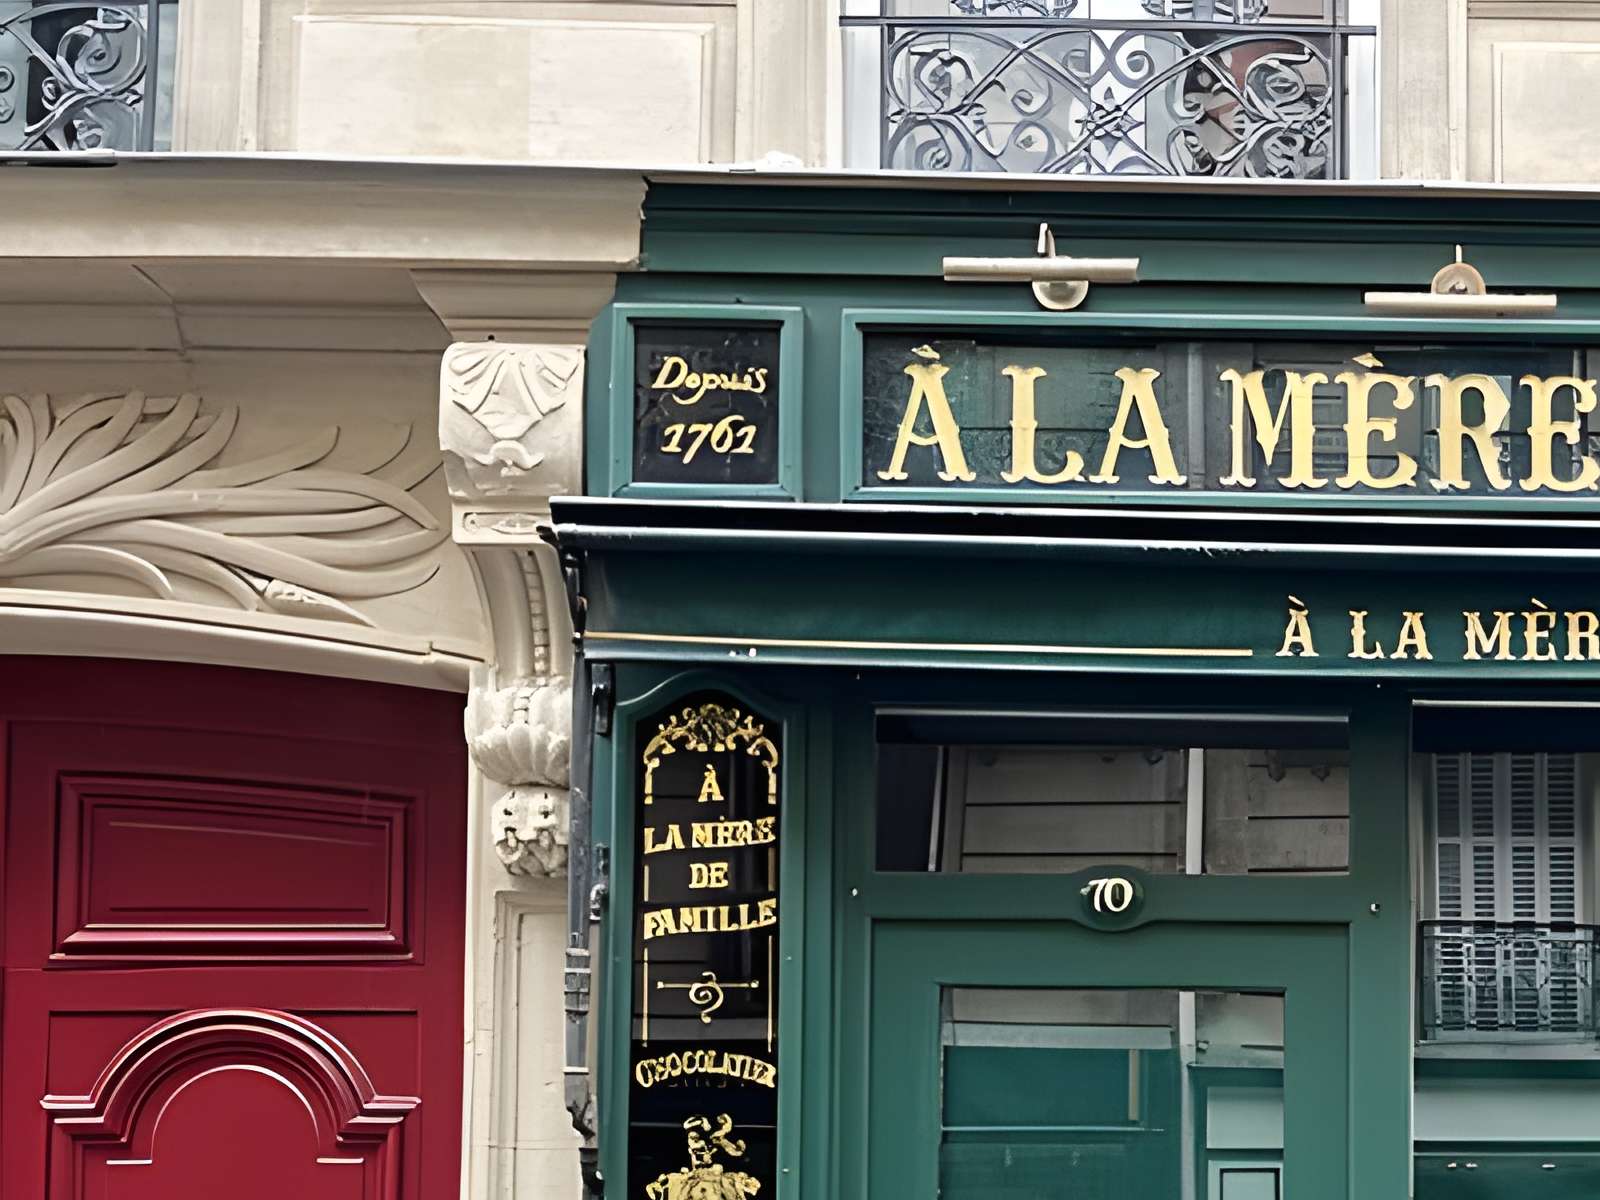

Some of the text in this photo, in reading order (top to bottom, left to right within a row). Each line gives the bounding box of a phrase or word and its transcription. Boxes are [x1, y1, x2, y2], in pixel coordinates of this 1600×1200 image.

[661, 414, 756, 464] 1761
[1002, 366, 1188, 486] LA
[1219, 352, 1600, 492] MÈRE
[1275, 594, 1319, 658] À
[1347, 610, 1433, 660] LA
[644, 824, 685, 854] LA
[689, 862, 729, 888] DE
[1080, 877, 1134, 912] 70
[644, 898, 777, 940] FAMILLE
